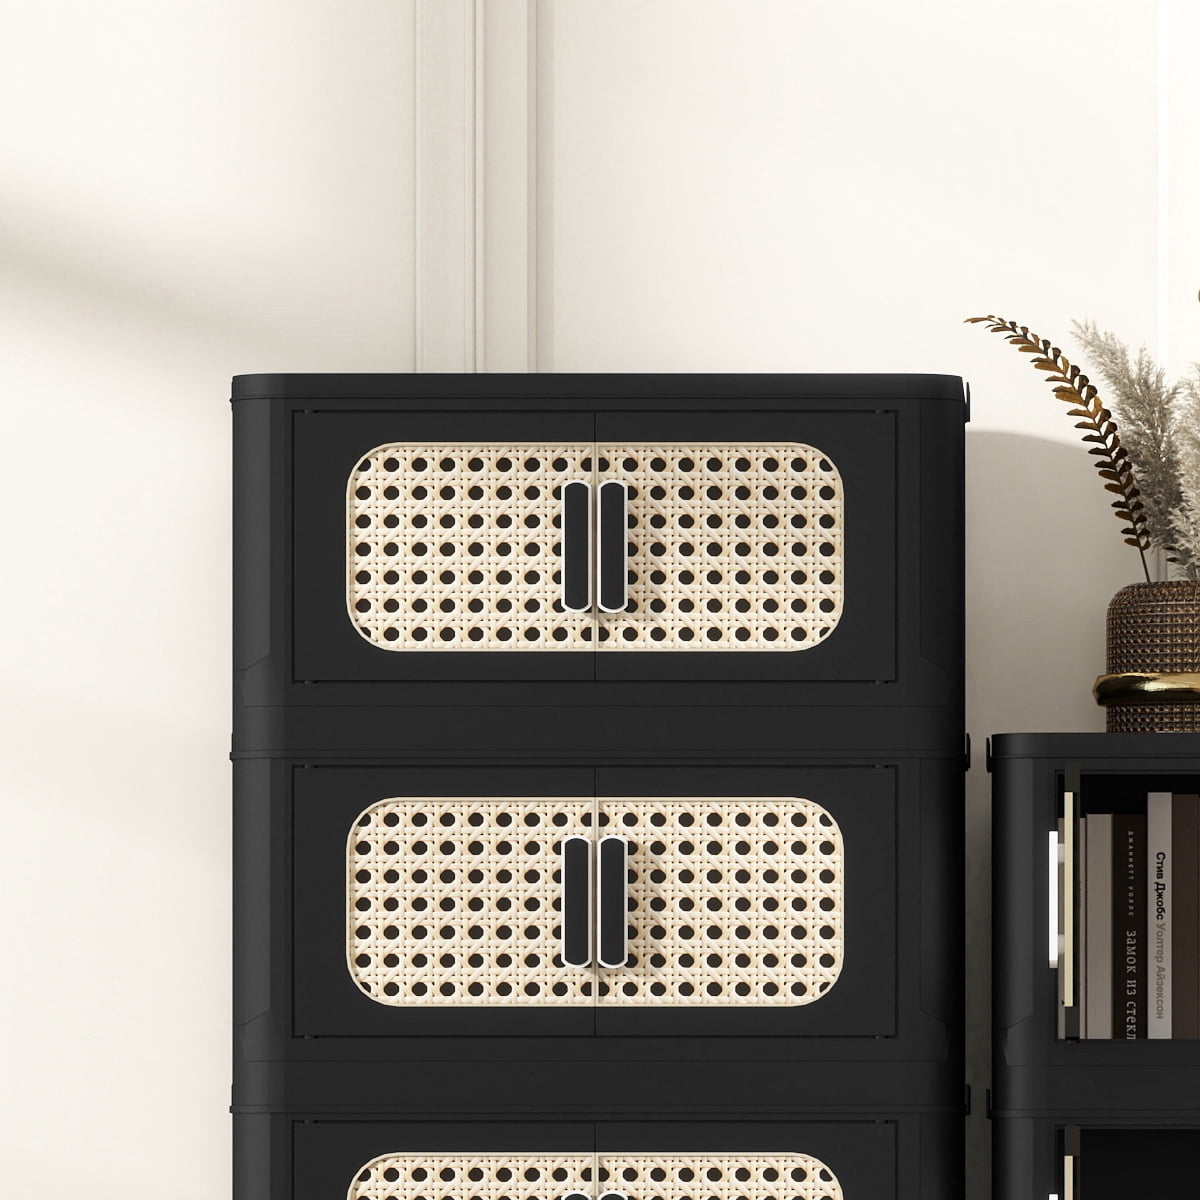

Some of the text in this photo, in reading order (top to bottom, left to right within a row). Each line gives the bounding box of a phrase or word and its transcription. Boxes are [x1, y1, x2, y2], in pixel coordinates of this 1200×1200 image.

[1126, 931, 1137, 972] замок
[1154, 852, 1165, 1018] Стив Джобс Уолтер Айзексон
[1126, 980, 1136, 995] из
